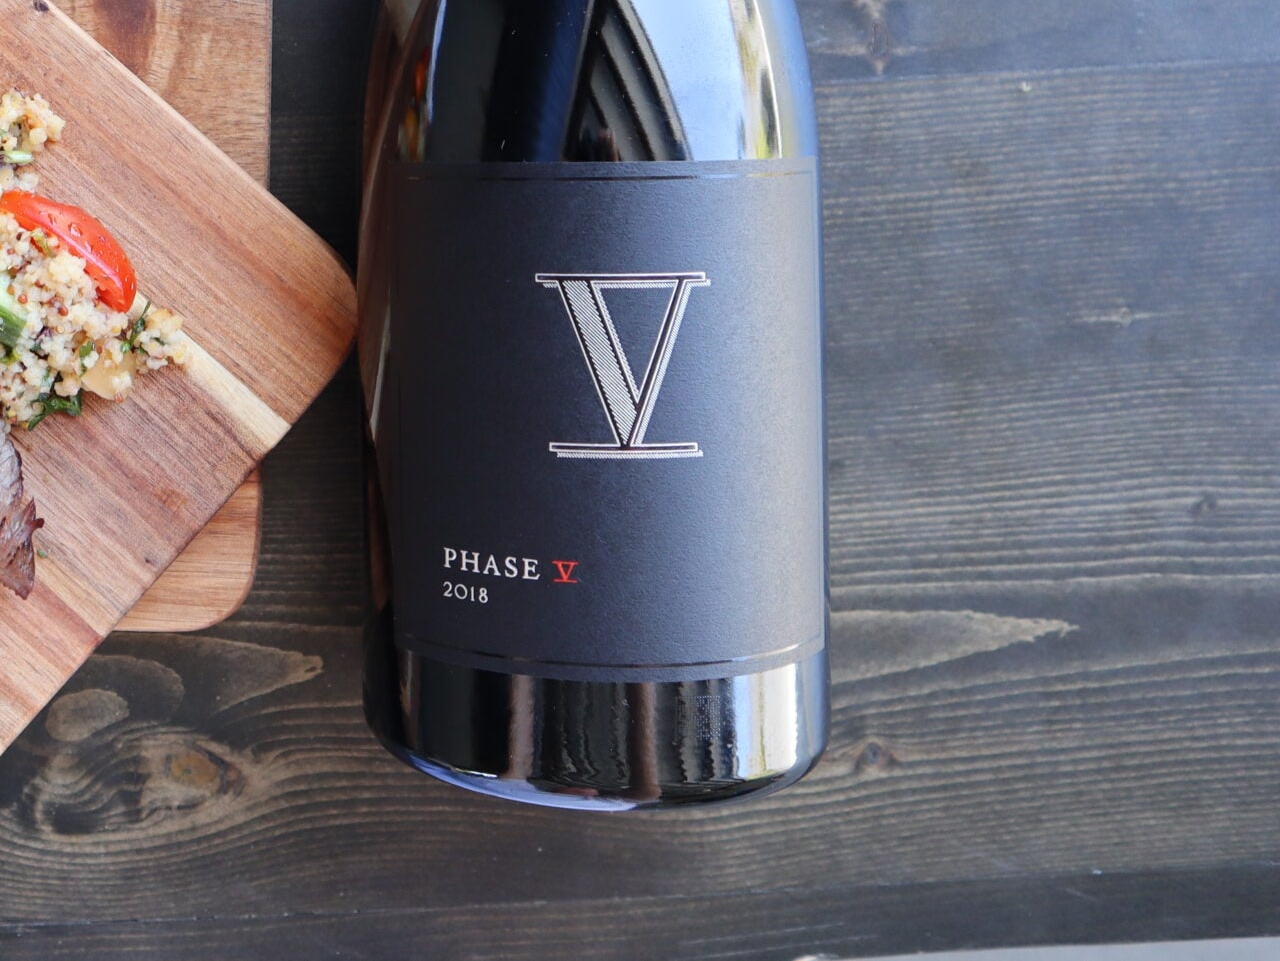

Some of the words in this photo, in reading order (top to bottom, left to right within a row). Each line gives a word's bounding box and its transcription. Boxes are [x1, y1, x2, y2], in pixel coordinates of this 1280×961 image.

[535, 272, 711, 459] V
[443, 546, 541, 581] PHASE
[552, 560, 580, 584] V
[442, 581, 489, 604] 2018
